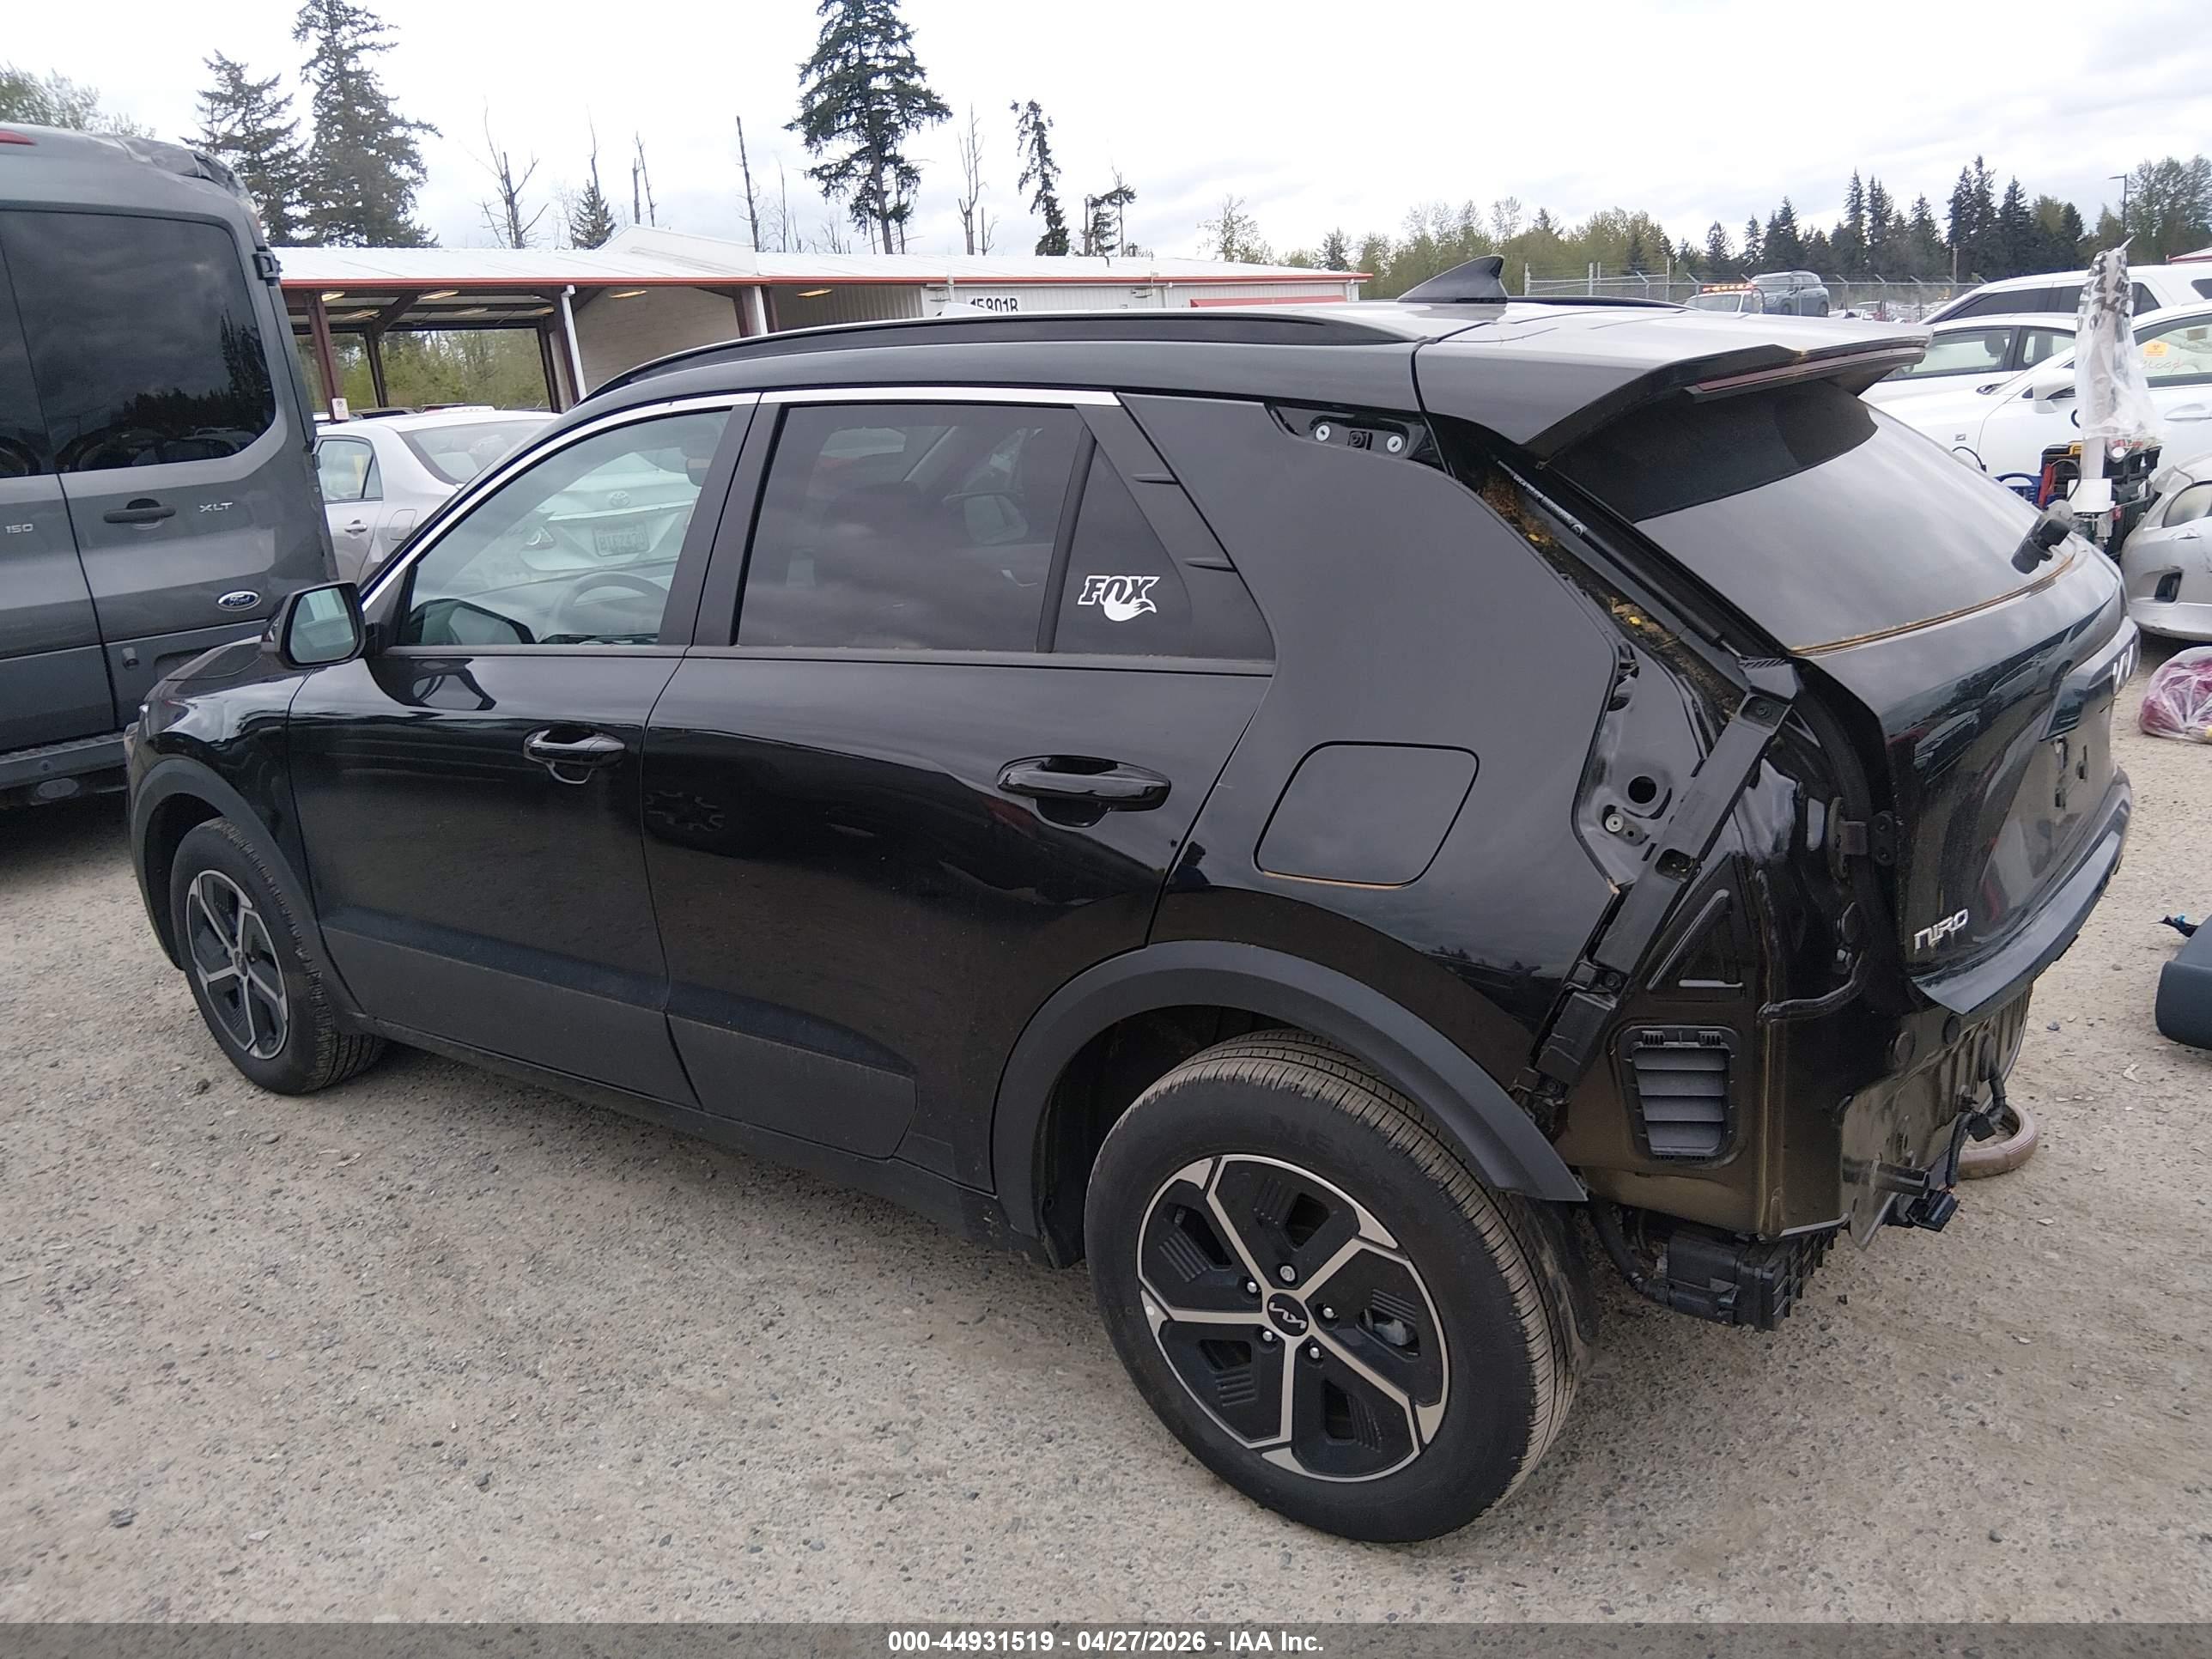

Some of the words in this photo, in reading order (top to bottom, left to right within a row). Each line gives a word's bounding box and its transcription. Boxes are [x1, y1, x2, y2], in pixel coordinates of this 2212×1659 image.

[198, 501, 234, 513] XLT
[4, 523, 34, 533] 150
[1078, 575, 1160, 605] FOX
